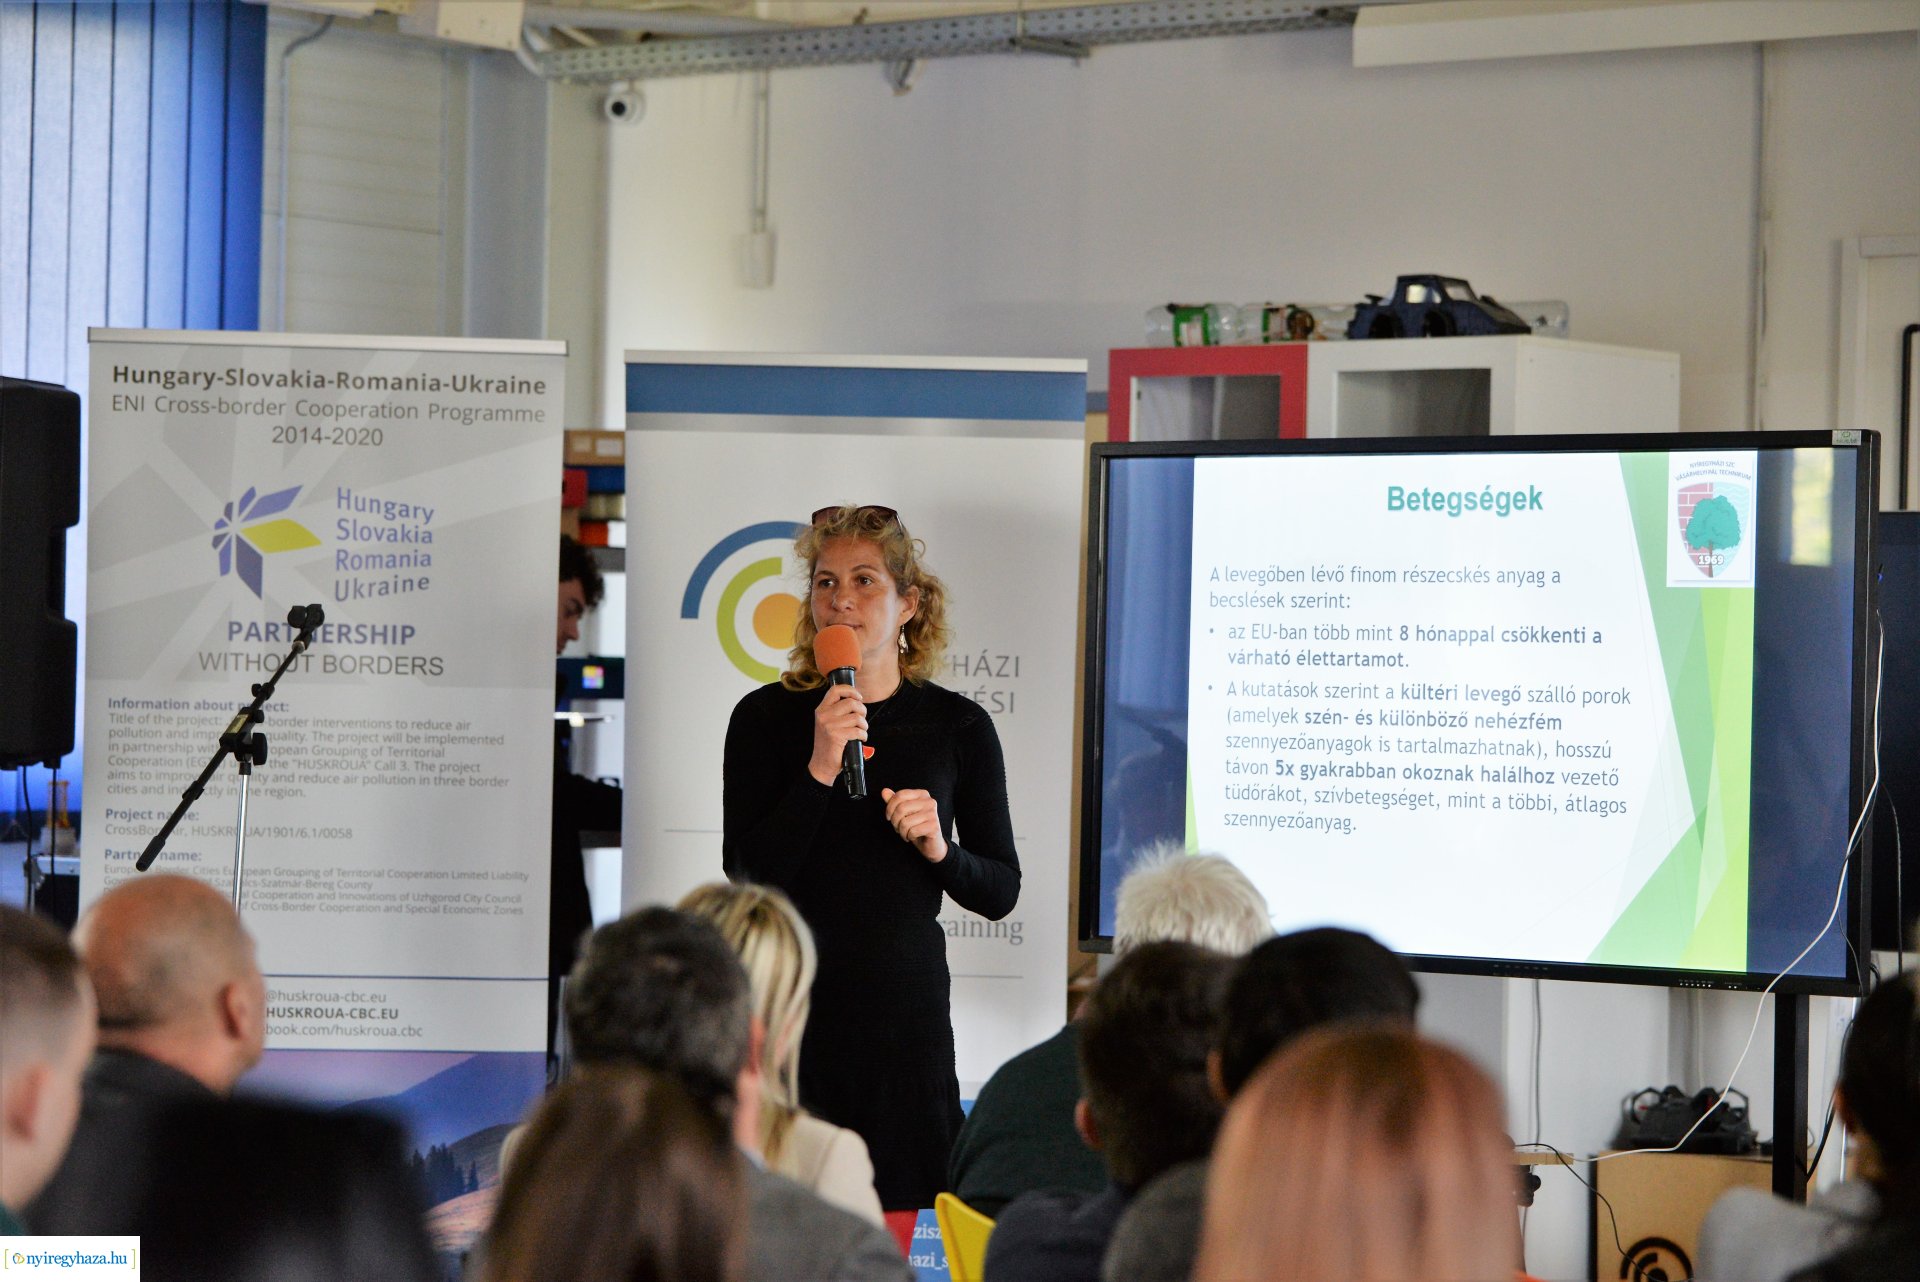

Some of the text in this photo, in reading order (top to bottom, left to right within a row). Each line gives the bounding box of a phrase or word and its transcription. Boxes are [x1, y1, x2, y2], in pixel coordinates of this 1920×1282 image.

[112, 365, 546, 395] Hungary-Slovakia-Romania-Ukraine
[112, 395, 545, 426] ENI Cross-border Cooperation Programme
[272, 426, 383, 446] 2014-2020
[336, 487, 434, 525] Hungary
[1387, 484, 1544, 518] Betegségek
[336, 518, 433, 545] Slovakia
[335, 549, 432, 572] Romania
[1698, 555, 1724, 565] 1969
[1210, 564, 1561, 588] A levegőben lévő finom részecskés anyag a
[334, 574, 430, 602] Ukraine
[1209, 590, 1351, 609] becslések szerint:
[1228, 623, 1602, 647] az EU-ban több mint 8 hónappal csökkenti a
[198, 652, 444, 676] WITHOUT BORDERS
[952, 649, 1019, 677] HÁZI
[1228, 648, 1409, 668] várható élettartamot.
[1227, 680, 1631, 708] A kutatások szerint a kültéri levegő szálló porok
[108, 698, 289, 714] Information about pect:
[109, 713, 135, 724] Title
[138, 713, 150, 724] of
[154, 714, 174, 725] the
[177, 714, 222, 728] project:
[312, 717, 392, 730] interventions
[395, 719, 408, 730] to
[411, 719, 452, 731] reduce
[455, 719, 472, 731] air
[1227, 706, 1562, 730] (amelyek szén- és különböző nehézfém
[108, 727, 163, 742] pollution
[165, 728, 189, 739] and
[267, 730, 308, 743] quality.
[311, 730, 333, 742] The
[337, 731, 379, 746] project
[383, 731, 402, 743] will
[406, 732, 420, 744] be
[424, 732, 504, 747] implemented
[1226, 732, 1611, 760] szennyezőanyagok is tartalmazhatnak), hosszú
[108, 741, 119, 751] in
[122, 741, 195, 755] partnership
[311, 746, 367, 760] Grouping
[371, 746, 384, 757] of
[387, 746, 445, 758] Territorial
[107, 755, 183, 769] Cooperation
[269, 760, 288, 770] the
[374, 760, 396, 771] Call
[400, 761, 410, 772] 3.
[414, 761, 436, 772] The
[439, 762, 480, 776] project
[1226, 757, 1619, 786] távon 5x gyakrabban okoznak halálhoz vezető
[107, 770, 136, 781] aims
[140, 771, 151, 781] to
[154, 771, 197, 785] improv
[272, 773, 295, 784] and
[298, 773, 340, 785] reduce
[343, 773, 358, 785] air
[362, 774, 416, 787] pollution
[419, 775, 430, 786] in
[433, 775, 465, 787] three
[469, 775, 510, 787] border
[107, 784, 137, 795] cities
[141, 784, 165, 795] and
[264, 786, 306, 800] region.
[1225, 783, 1627, 817] tüdőrákot, szívbetegséget, mint a többi, átlagos
[105, 808, 199, 822] Project nae:
[1223, 811, 1357, 835] szennyezőanyag.
[104, 849, 202, 862] Partn name:
[223, 867, 271, 879] Eupean
[273, 867, 321, 880] Grouping
[323, 868, 333, 878] of
[336, 868, 385, 879] Territorial
[387, 869, 449, 881] Cooperation
[451, 870, 488, 881] Limited
[491, 871, 530, 883] Liability
[337, 880, 373, 891] County
[252, 890, 313, 902] Cooperation
[316, 891, 336, 901] and
[339, 892, 399, 903] Innovations
[401, 892, 411, 903] of
[412, 893, 461, 905] Uzhgorod
[463, 893, 481, 905] City
[484, 894, 522, 904] Council
[251, 902, 316, 912] Cross-Border
[319, 903, 381, 914] Cooperation
[383, 904, 402, 914] and
[405, 904, 440, 916] Special
[443, 905, 490, 915] Economic
[493, 905, 524, 916] Zones
[938, 914, 1024, 945] aining
[264, 990, 387, 1004] @huskroua-cbc.eu
[266, 1007, 399, 1020] HUSKROUA-CBC.EU
[264, 1024, 423, 1038] book.com/huskroua.cbc
